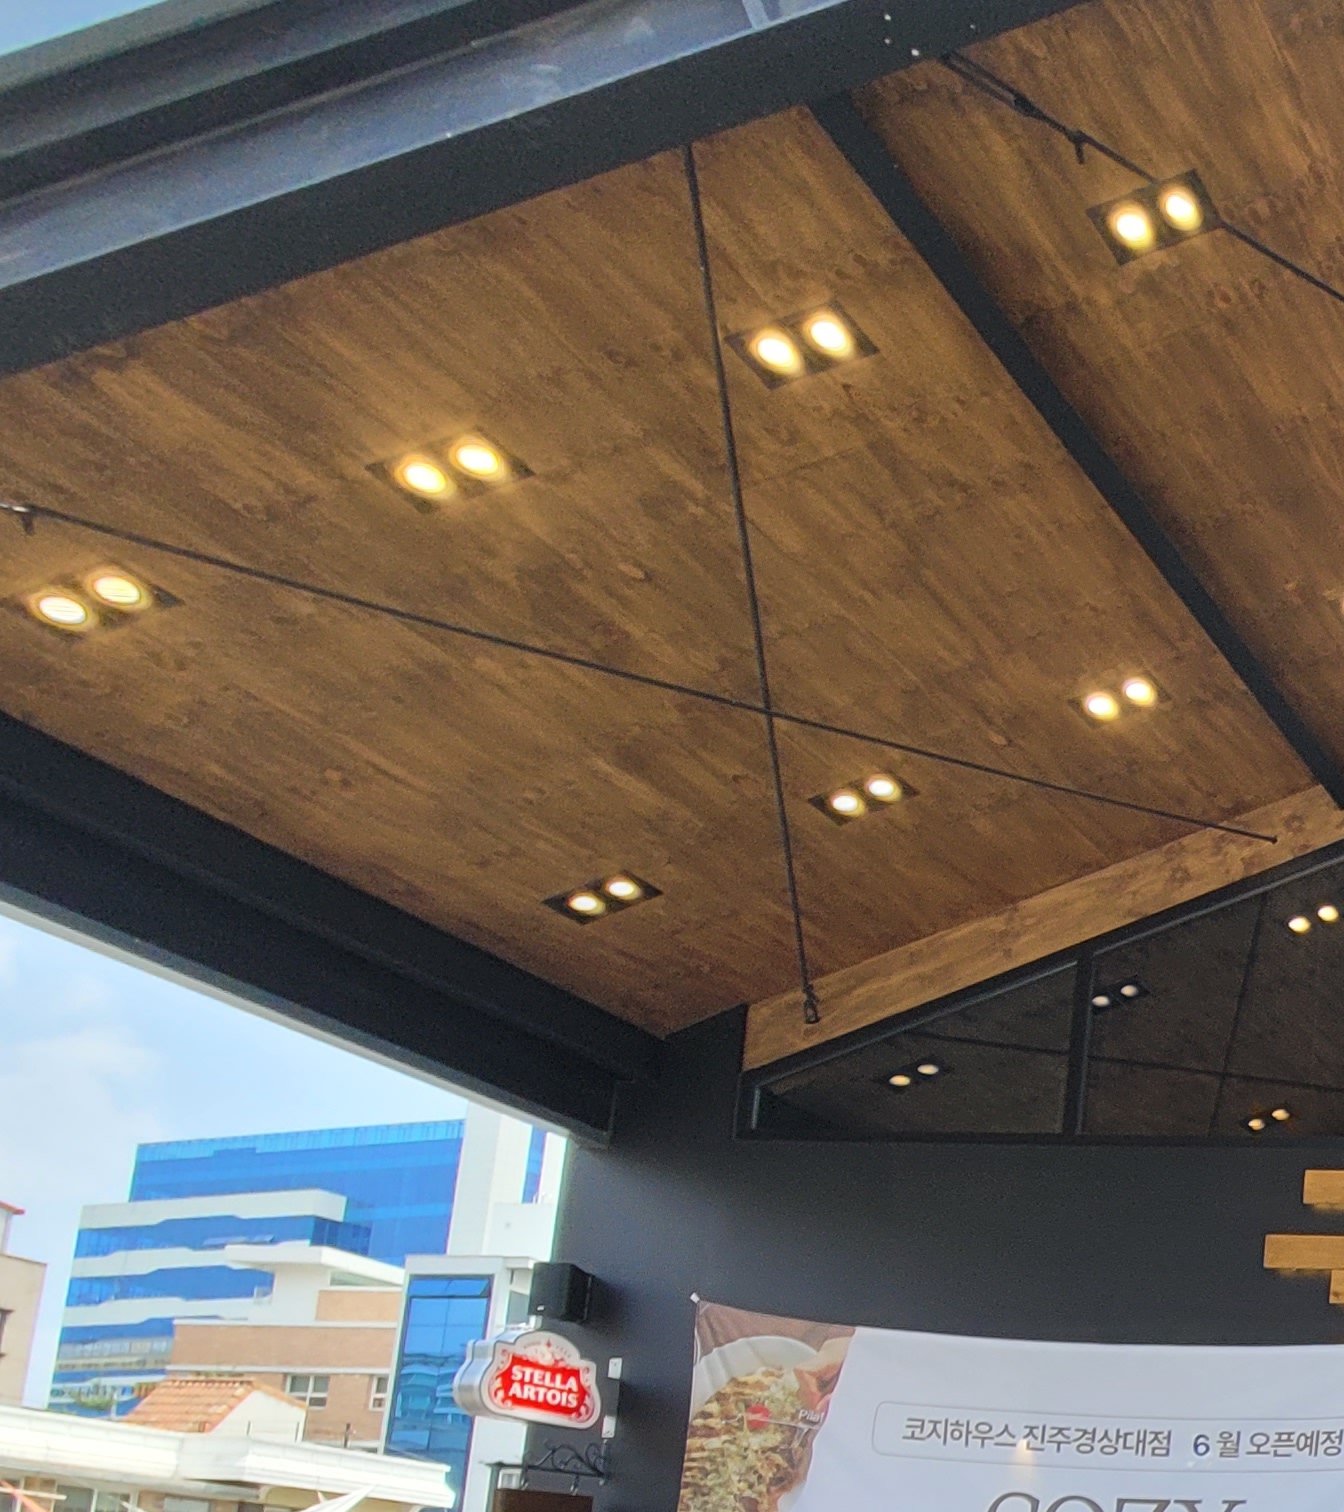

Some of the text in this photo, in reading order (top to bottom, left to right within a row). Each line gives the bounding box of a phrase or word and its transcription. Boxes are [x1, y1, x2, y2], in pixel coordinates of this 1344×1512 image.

[511, 1365, 578, 1392] STELLA
[508, 1383, 578, 1409] ARTOIS
[902, 1416, 1344, 1458] 코지하우스 진주경상대점 6 월 오픈예정
